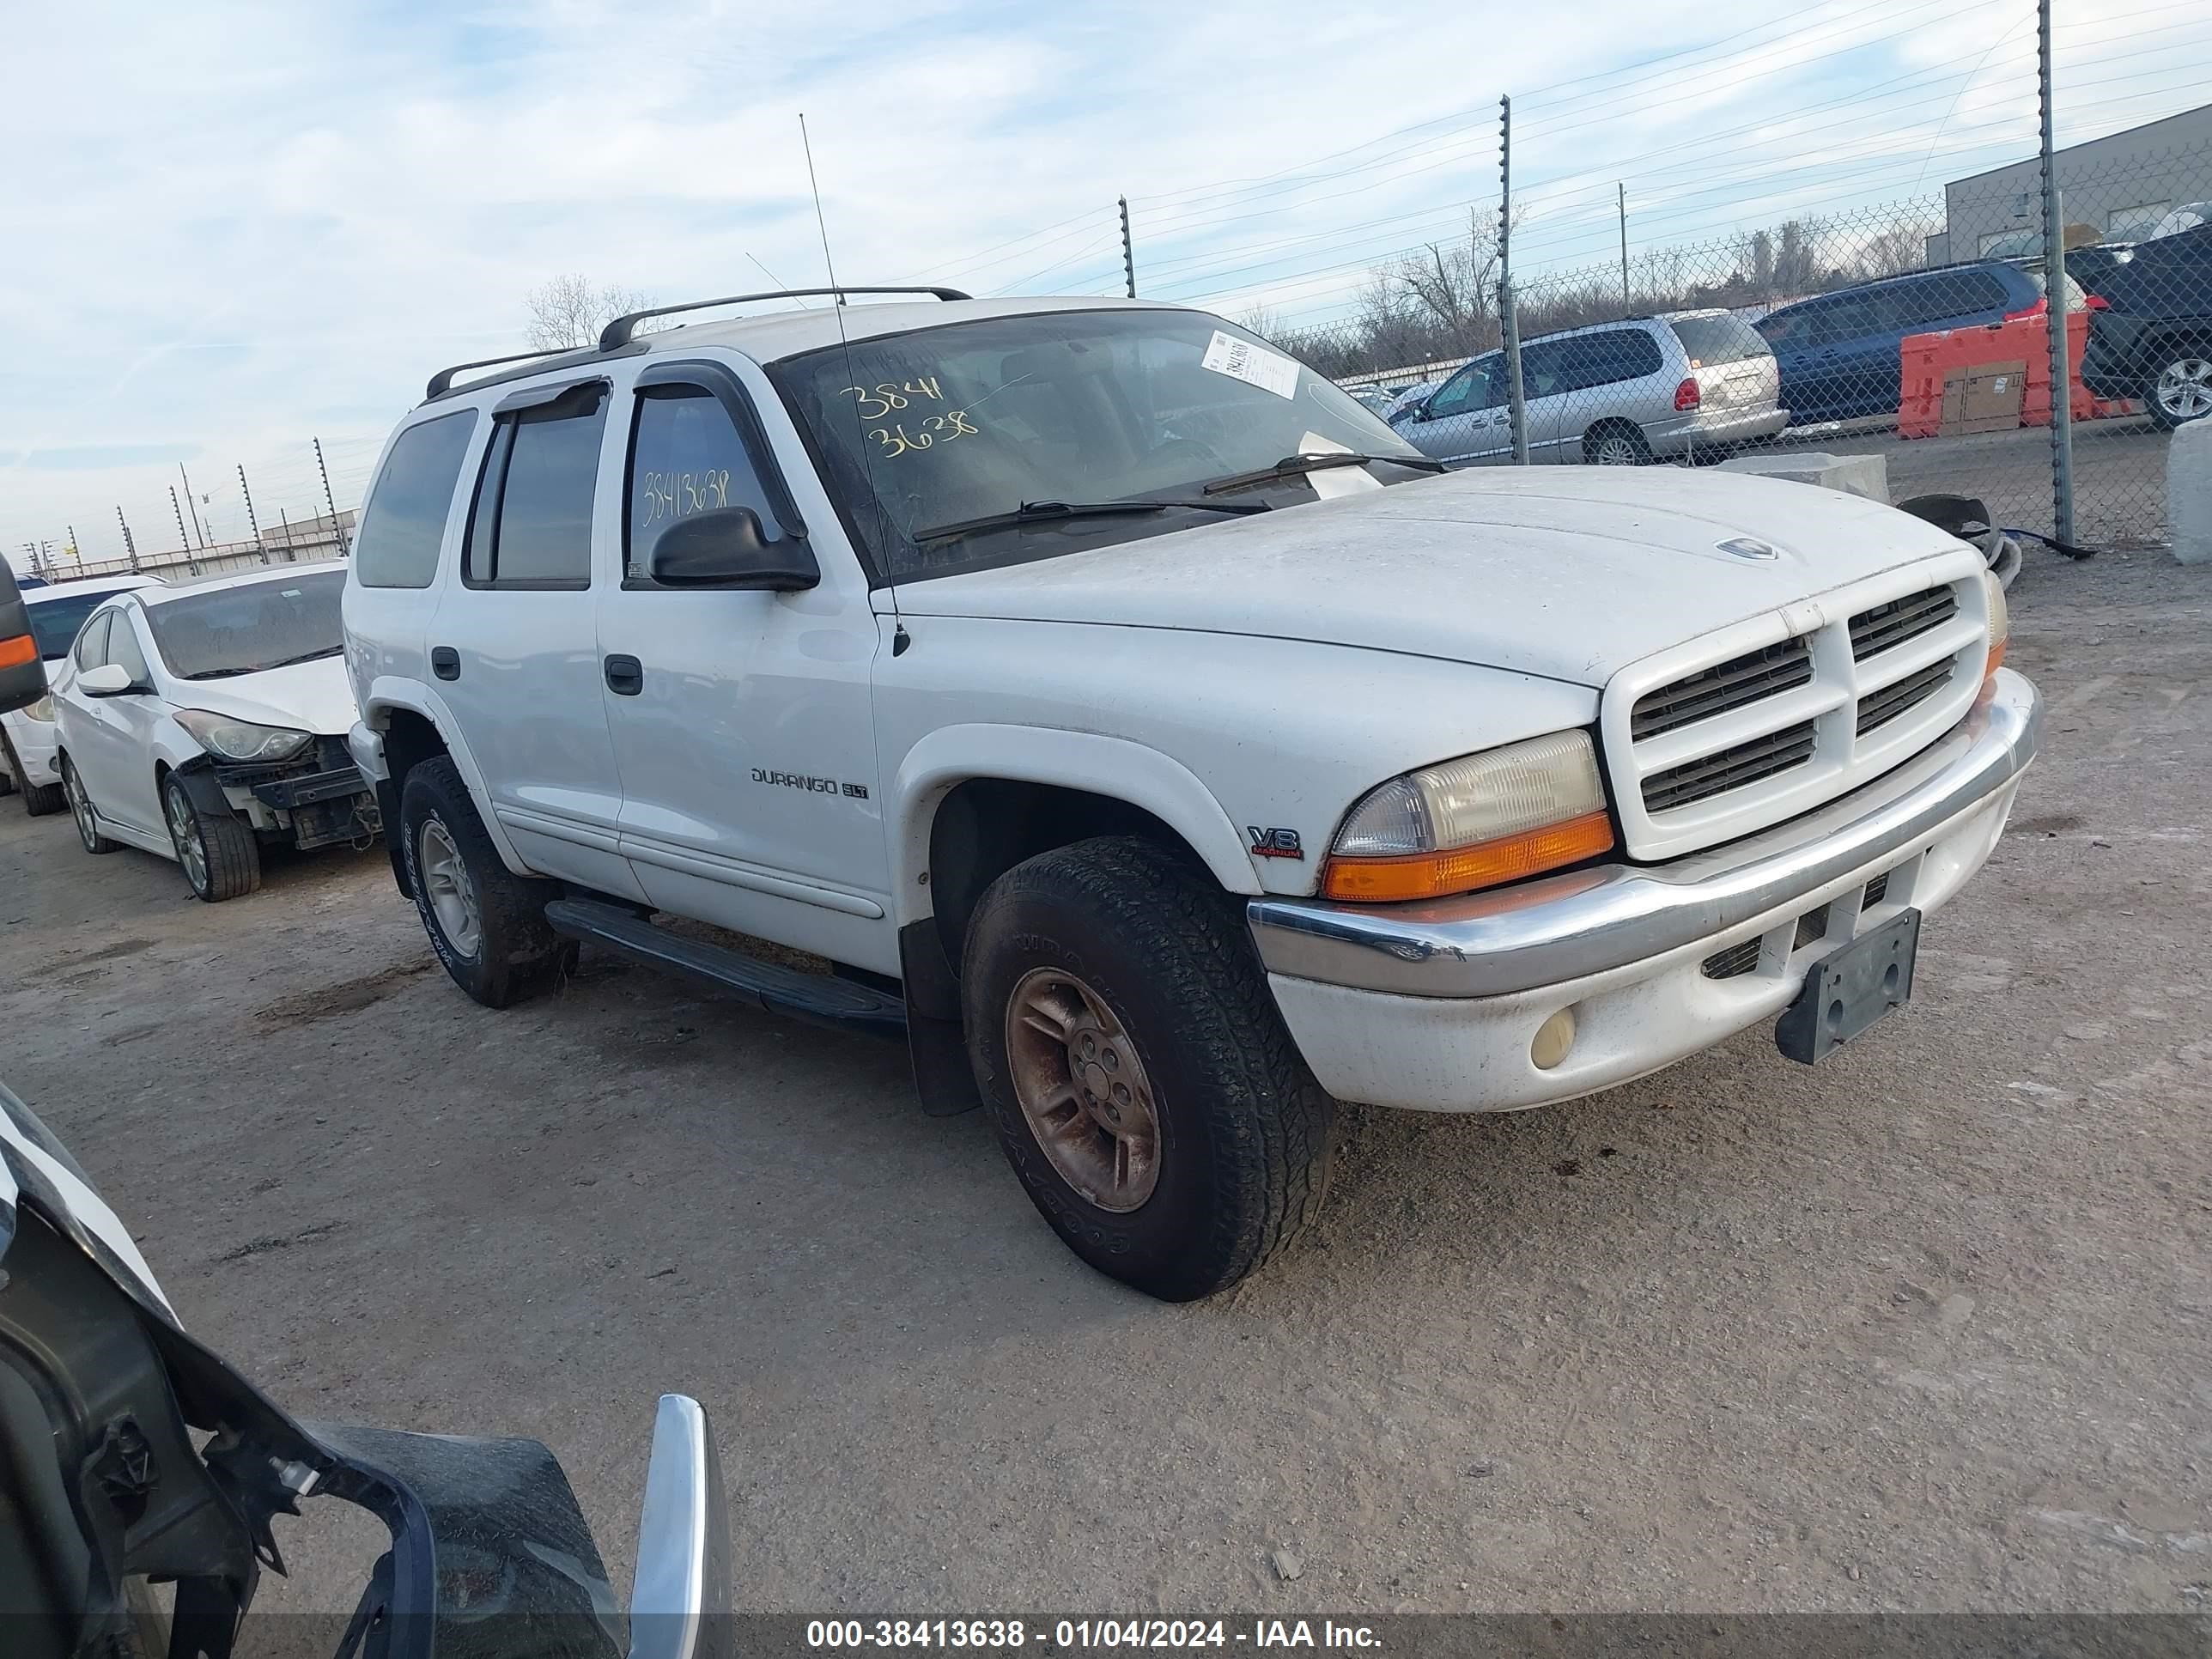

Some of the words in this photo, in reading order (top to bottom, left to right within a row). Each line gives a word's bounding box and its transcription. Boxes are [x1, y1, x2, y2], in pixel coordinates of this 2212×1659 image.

[839, 377, 944, 420] 3841
[868, 410, 979, 458] 3638
[642, 469, 729, 527] 38413638
[750, 768, 838, 794] DURANGO
[842, 782, 870, 799] SLT
[1247, 825, 1301, 851] V8
[1252, 846, 1302, 859] MAGNUM
